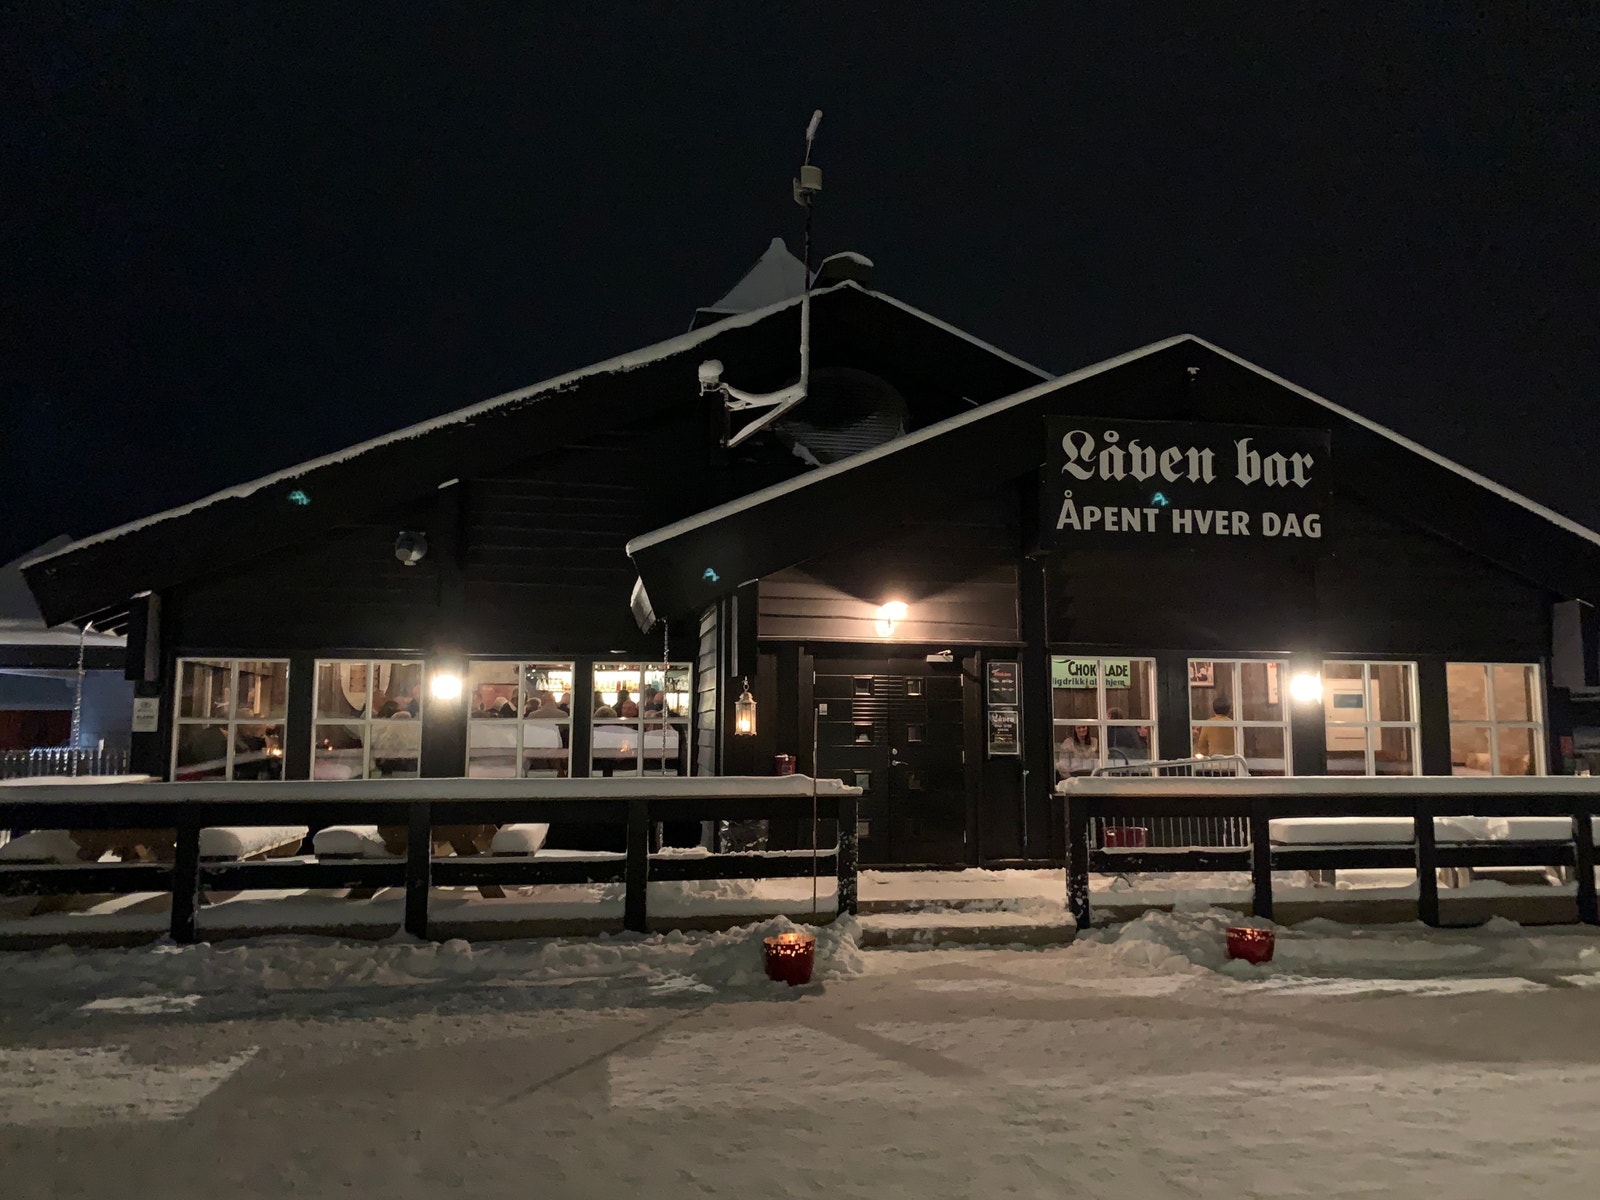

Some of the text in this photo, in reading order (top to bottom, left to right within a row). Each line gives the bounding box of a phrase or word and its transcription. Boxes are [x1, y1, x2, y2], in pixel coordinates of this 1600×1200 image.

[1061, 429, 1315, 488] Låven bar
[1056, 489, 1322, 538] ÅPENT HVER DAG
[1068, 661, 1128, 677] CHOKLADE
